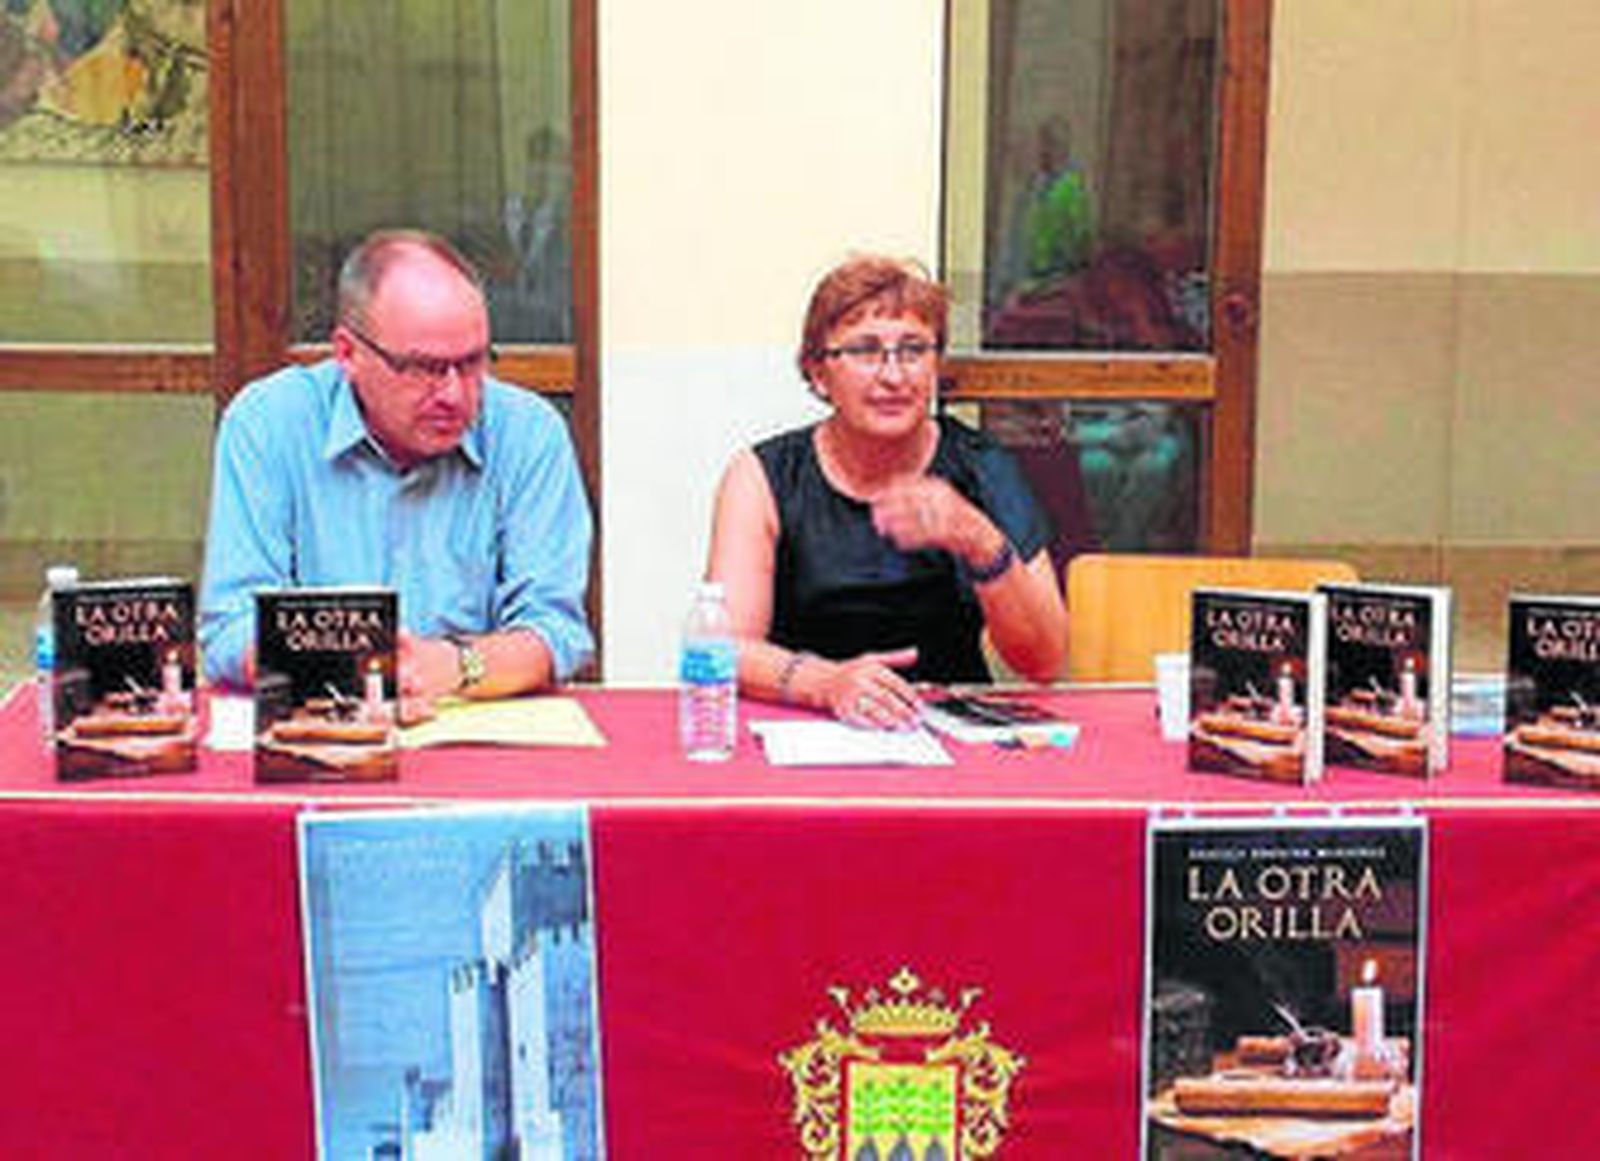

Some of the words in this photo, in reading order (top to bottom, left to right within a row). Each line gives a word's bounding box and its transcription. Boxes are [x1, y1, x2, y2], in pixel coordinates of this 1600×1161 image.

[76, 605, 106, 626] LA
[111, 601, 179, 622] OTRA
[277, 611, 308, 631] LA
[314, 610, 383, 630] OTRA
[1207, 610, 1233, 629] LA
[1237, 611, 1296, 634] OTRA
[1331, 605, 1356, 622] LA
[1360, 606, 1416, 629] OTRA
[85, 623, 170, 646] ORILLA
[1526, 617, 1558, 637] LA
[286, 630, 372, 652] ORILLA
[1211, 630, 1287, 652] ORILLA
[1188, 866, 1243, 900] LA
[1256, 865, 1383, 900] OTRA
[1205, 905, 1363, 940] ORILLA
